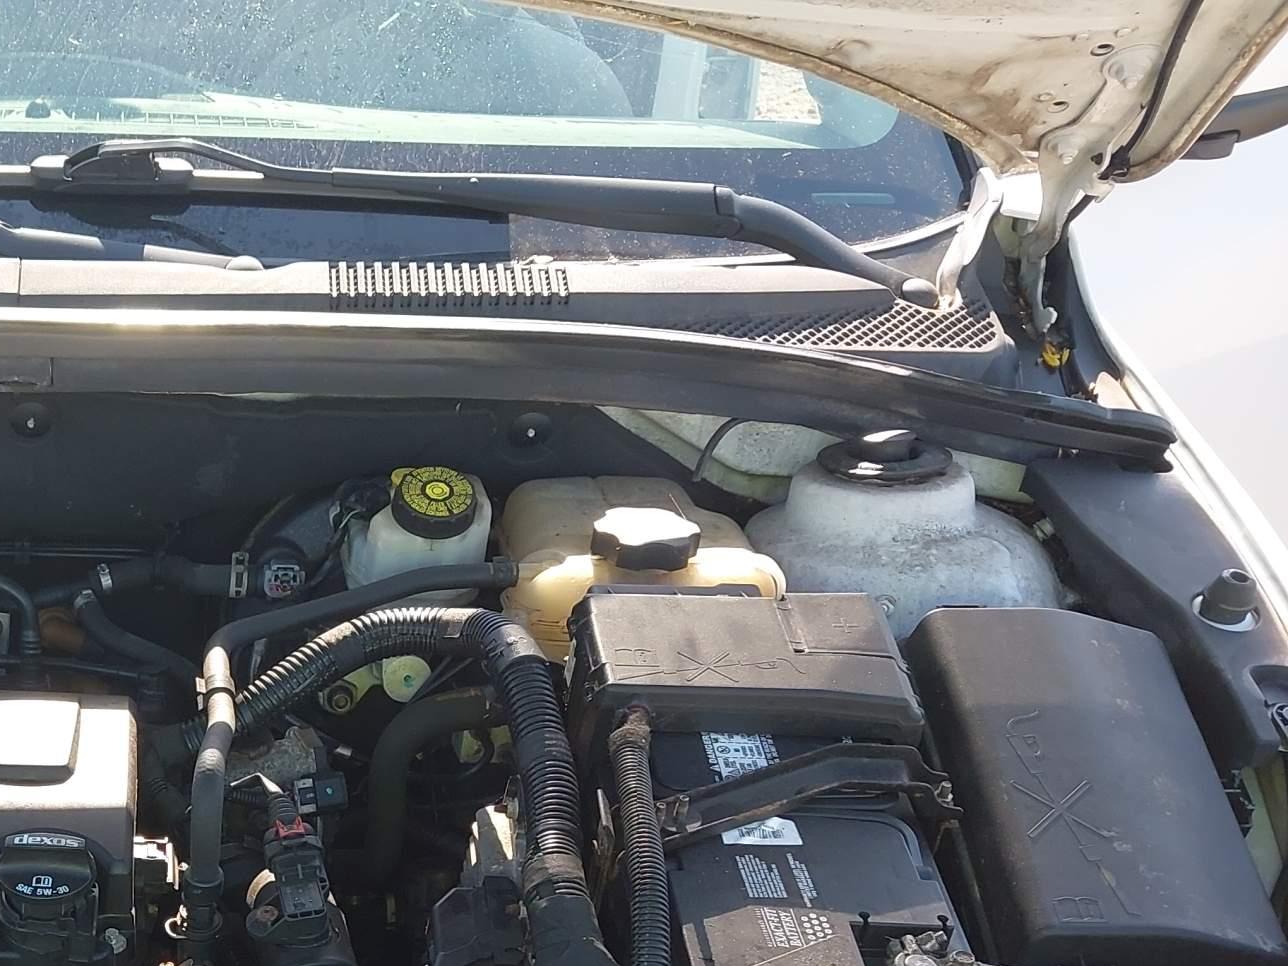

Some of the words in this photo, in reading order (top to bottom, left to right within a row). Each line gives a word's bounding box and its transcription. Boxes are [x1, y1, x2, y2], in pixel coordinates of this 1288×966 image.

[13, 834, 80, 848] dexos
[15, 883, 34, 895] SAE
[36, 885, 70, 896] 5W-30
[766, 908, 789, 948] EXACT-FIT
[778, 910, 802, 947] BATTERY
